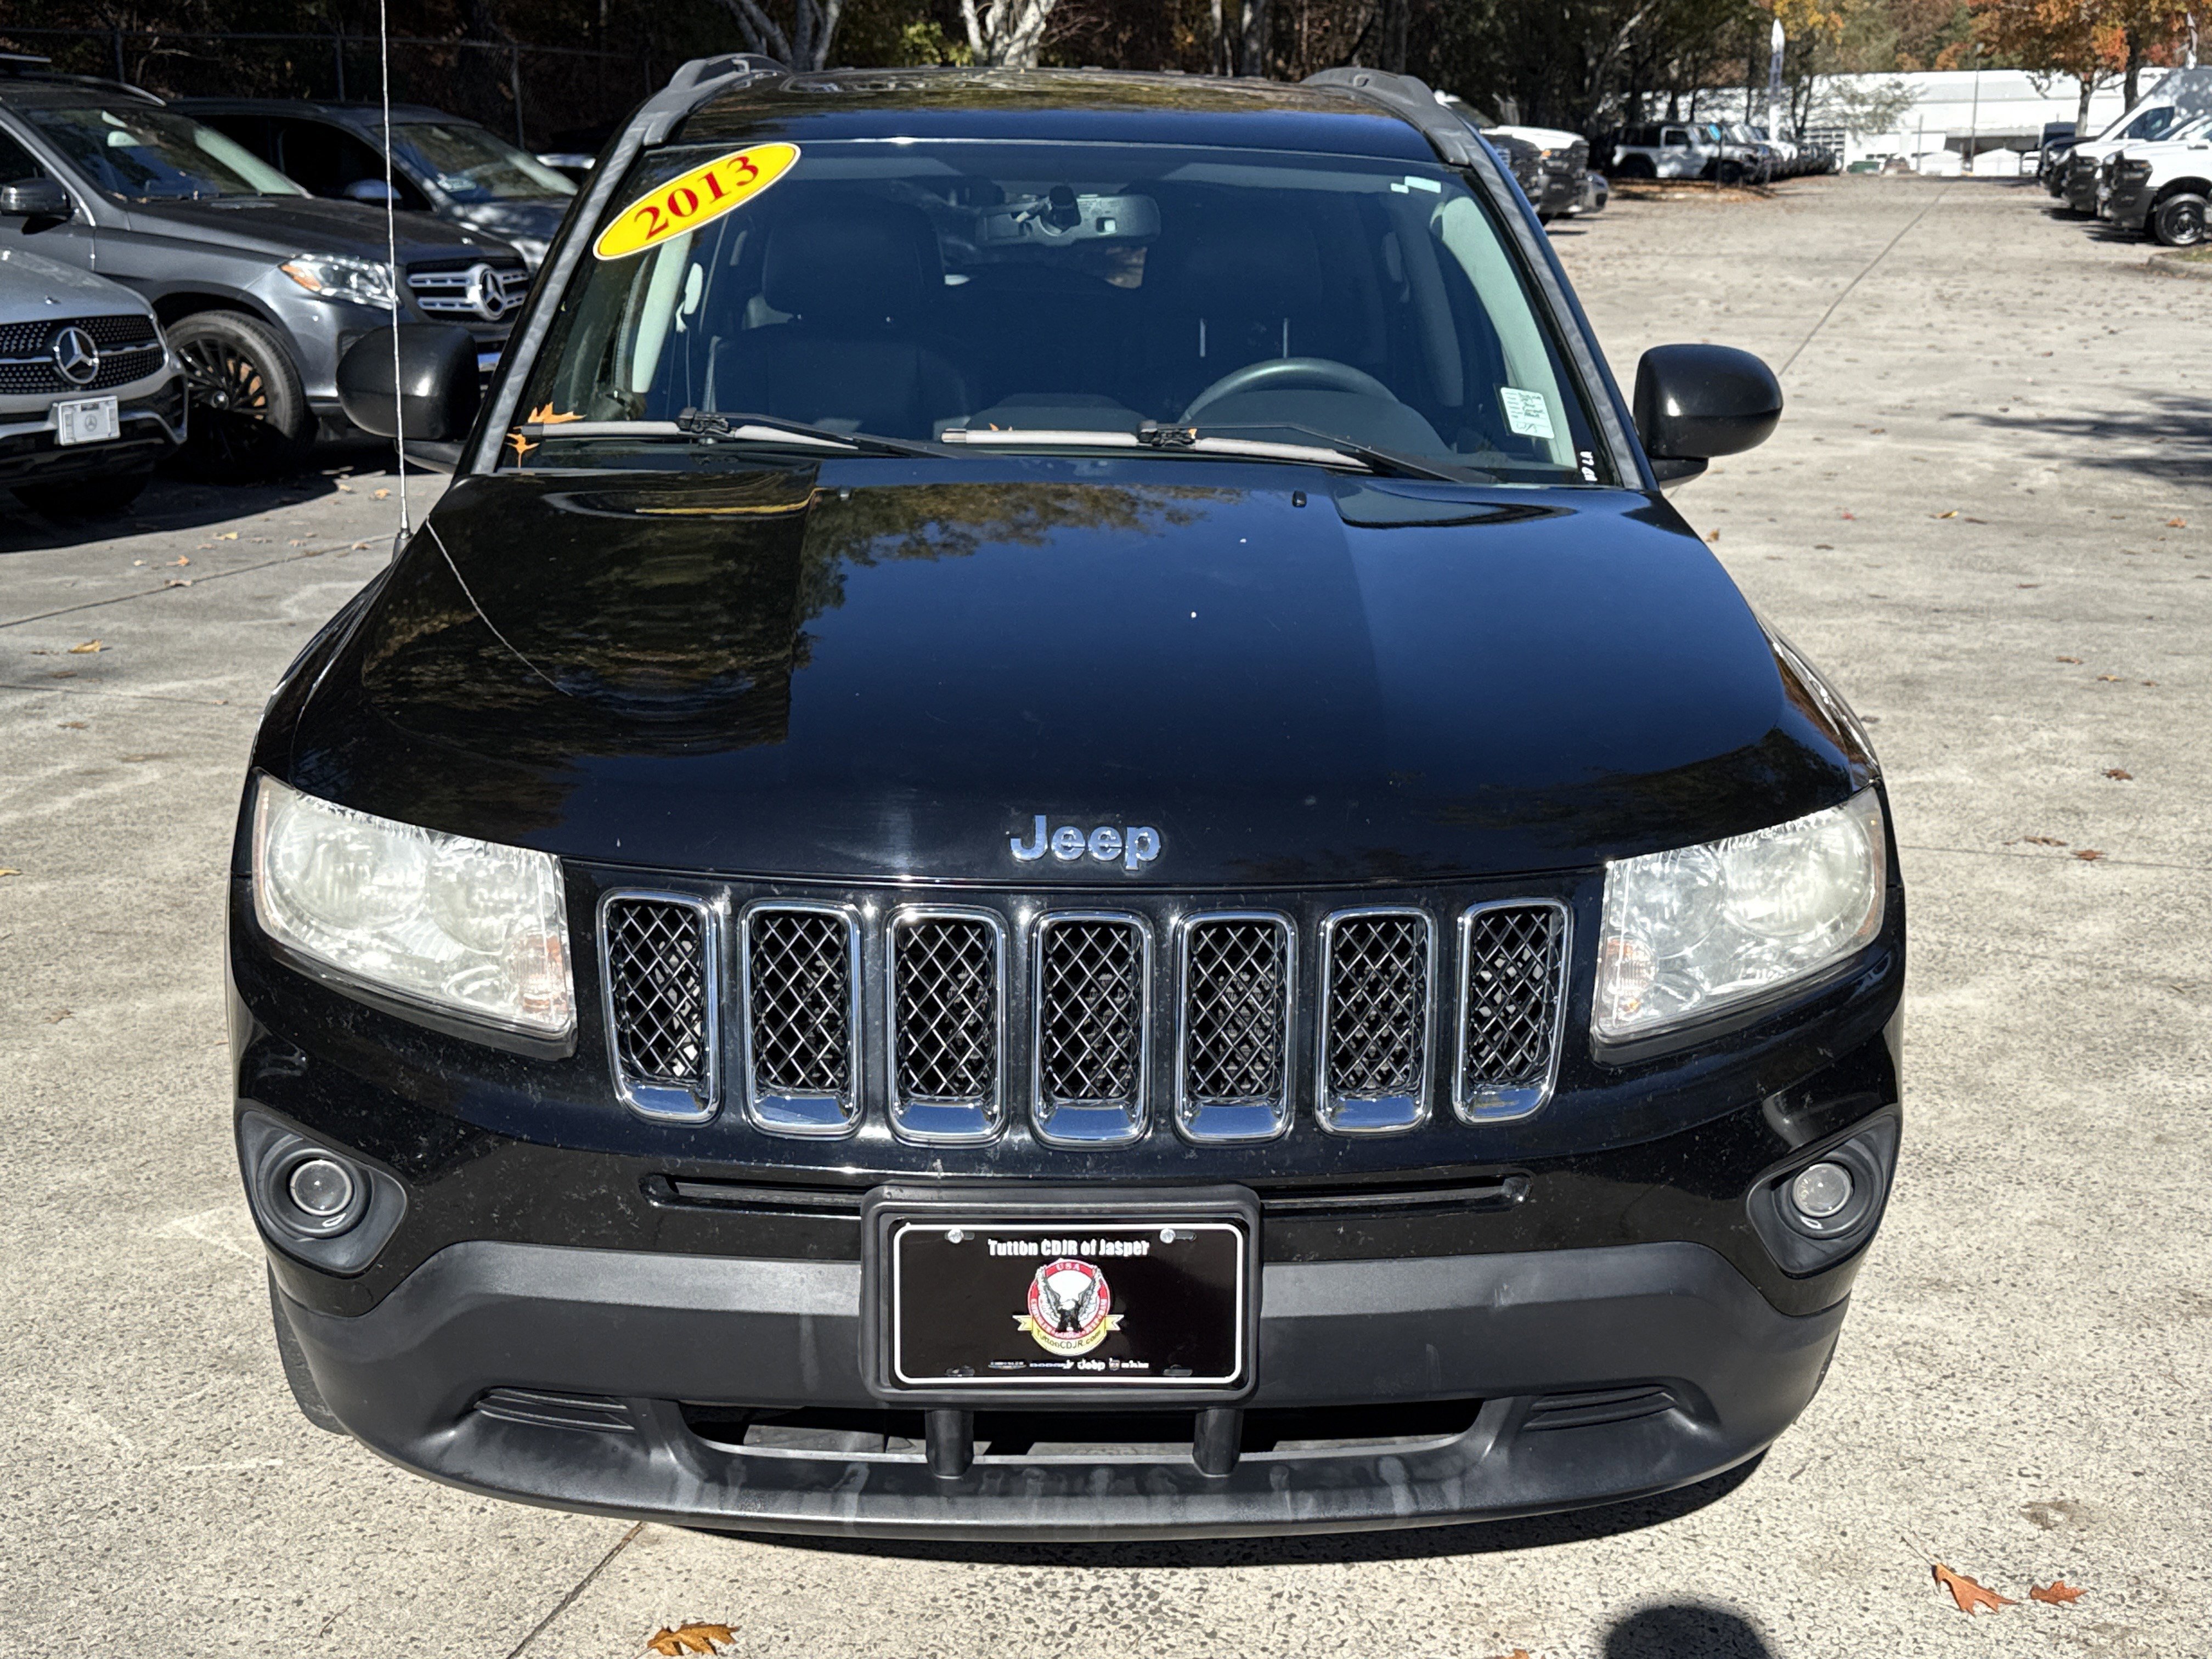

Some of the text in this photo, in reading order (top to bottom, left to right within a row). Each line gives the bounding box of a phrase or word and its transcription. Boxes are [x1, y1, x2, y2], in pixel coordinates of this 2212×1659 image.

[634, 156, 759, 240] 2013
[1010, 815, 1161, 871] Jeep
[988, 1238, 1150, 1257] Tutton CDJR of Jasper
[1056, 1262, 1080, 1271] USA
